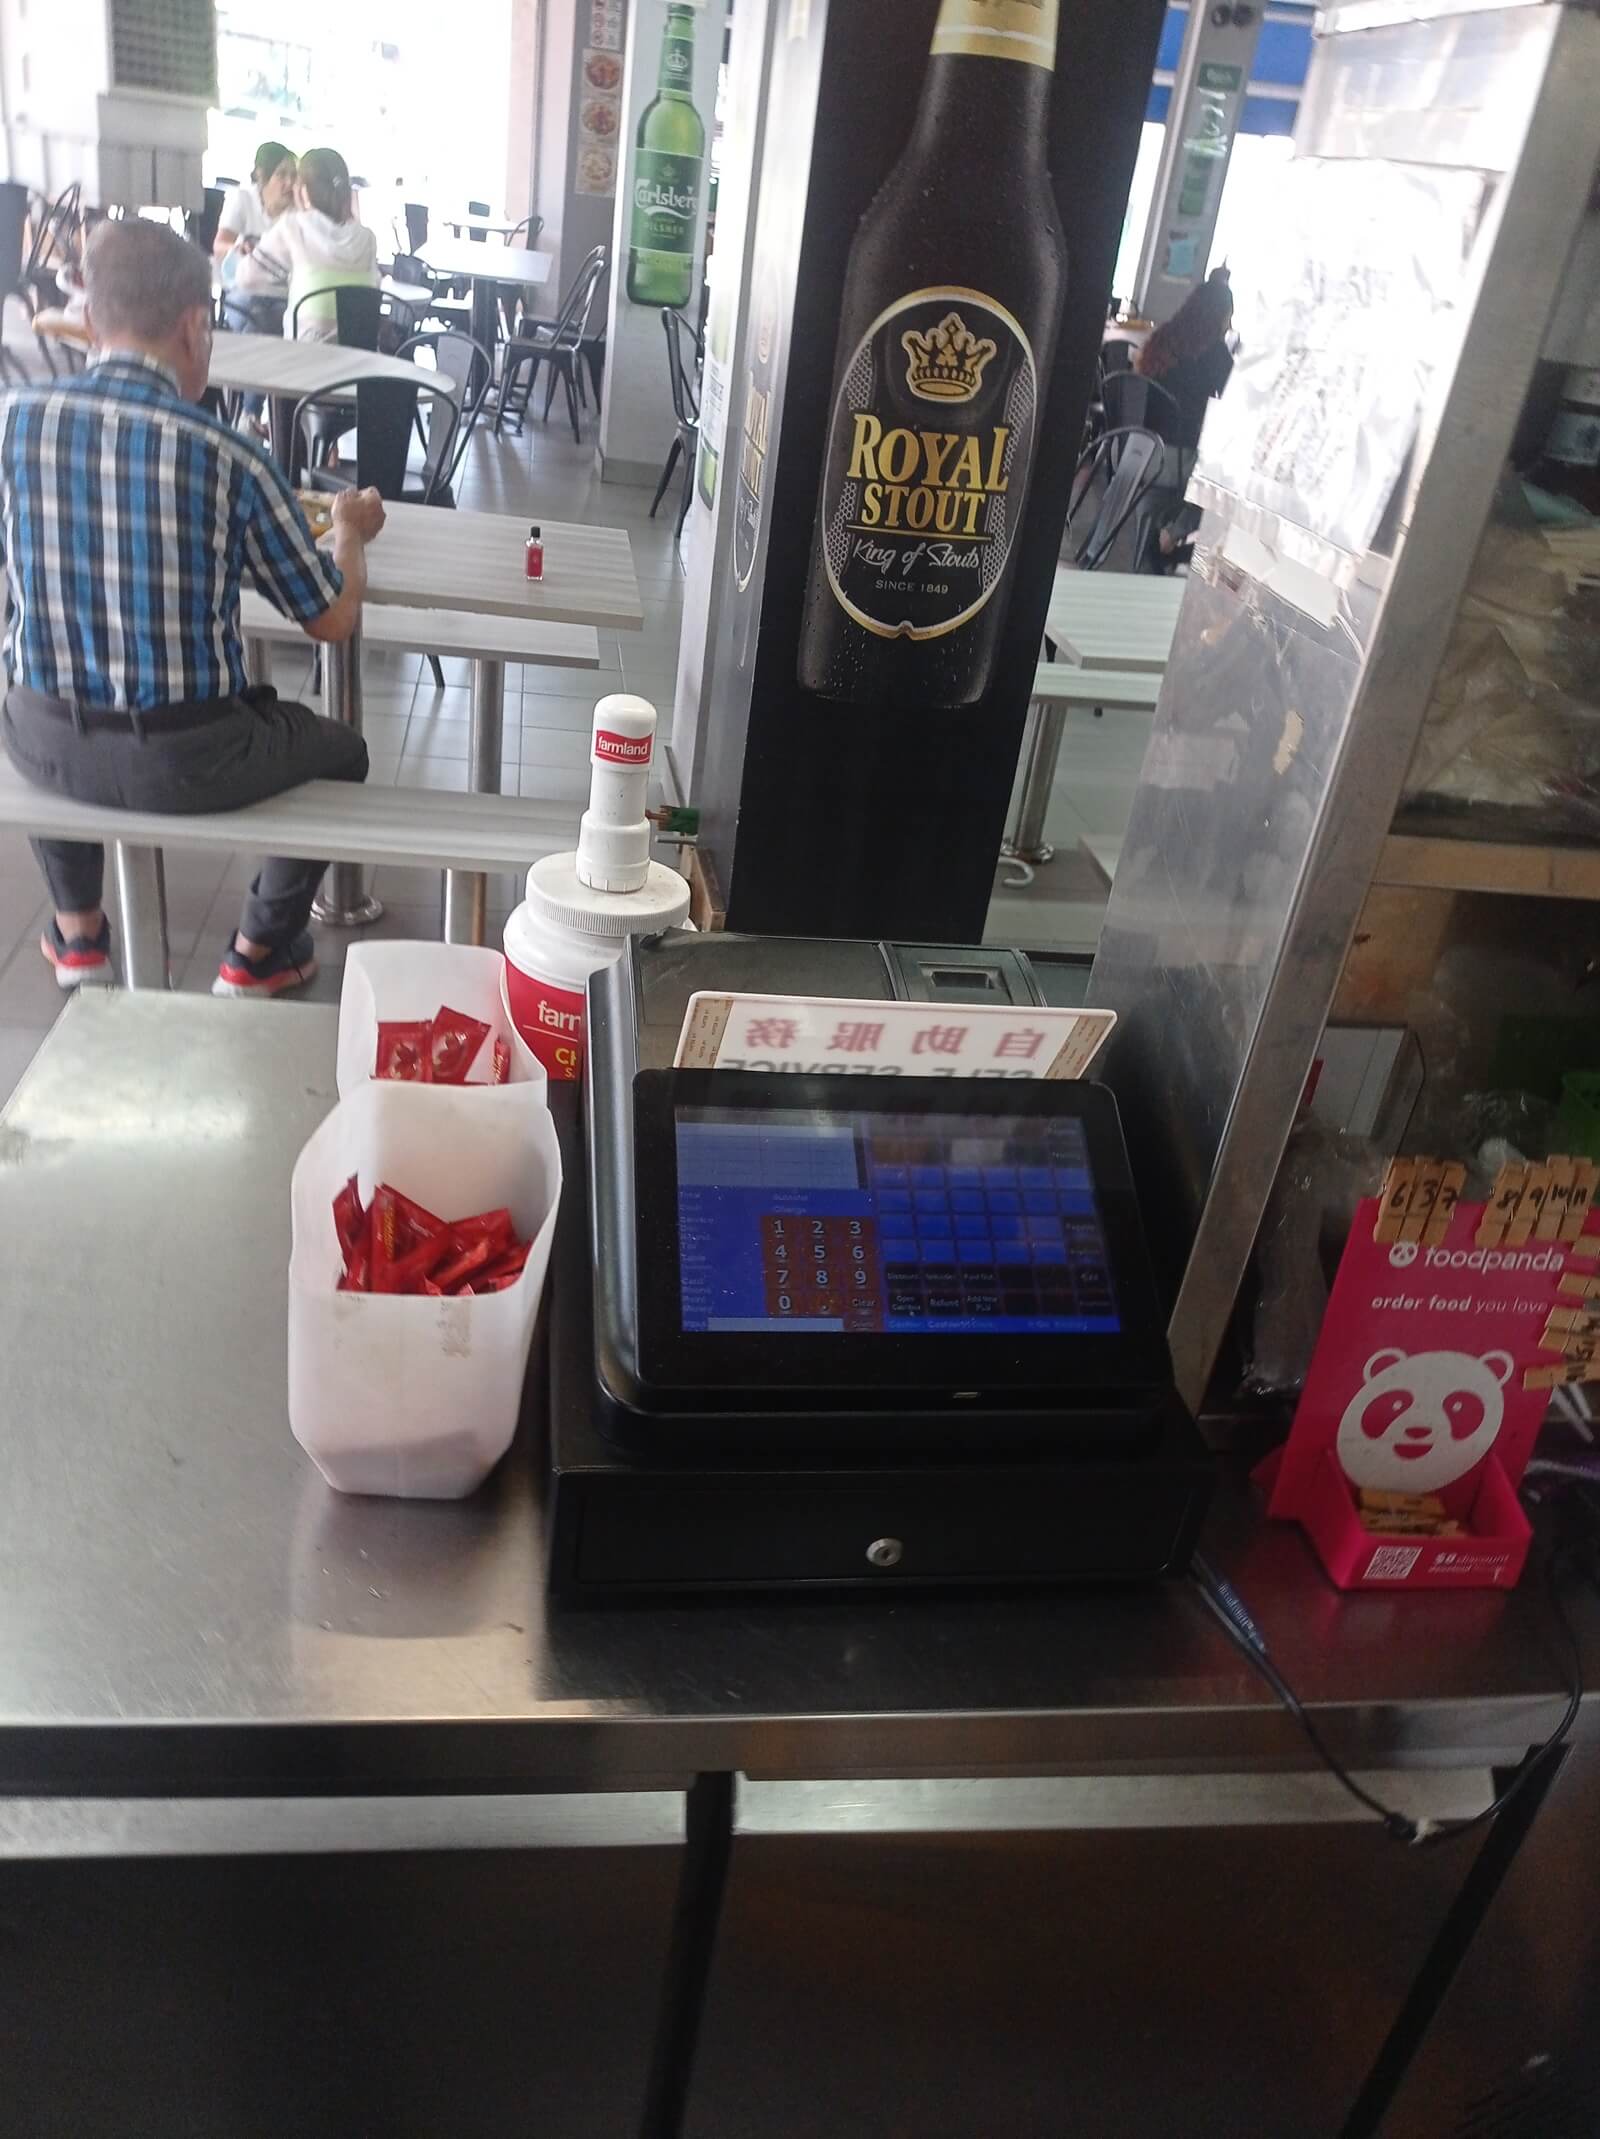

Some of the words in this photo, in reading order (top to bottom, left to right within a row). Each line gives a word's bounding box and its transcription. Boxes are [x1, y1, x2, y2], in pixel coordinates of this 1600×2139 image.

[847, 413, 1009, 491] ROYAL
[861, 483, 986, 532] STOUT
[853, 538, 897, 575] King
[901, 542, 925, 575] of
[926, 543, 980, 568] Stouts
[875, 579, 915, 592] SINCE
[920, 583, 949, 594] 1849
[598, 735, 649, 756] farmland
[1391, 1181, 1407, 1207] 6
[1419, 1179, 1440, 1208] 3
[1441, 1186, 1459, 1211] 7
[774, 1220, 784, 1233] 1
[812, 1221, 824, 1234] 2
[850, 1221, 861, 1234] 3
[775, 1245, 788, 1258] 4
[814, 1245, 825, 1258] 5
[852, 1246, 864, 1259] 6
[1424, 1245, 1565, 1275] foodpanda
[777, 1270, 788, 1283] 7
[816, 1270, 828, 1284] 8
[854, 1271, 866, 1284] 9
[779, 1295, 791, 1310] 0
[1371, 1293, 1424, 1310] order
[1428, 1294, 1472, 1312] food
[1475, 1302, 1507, 1316] you
